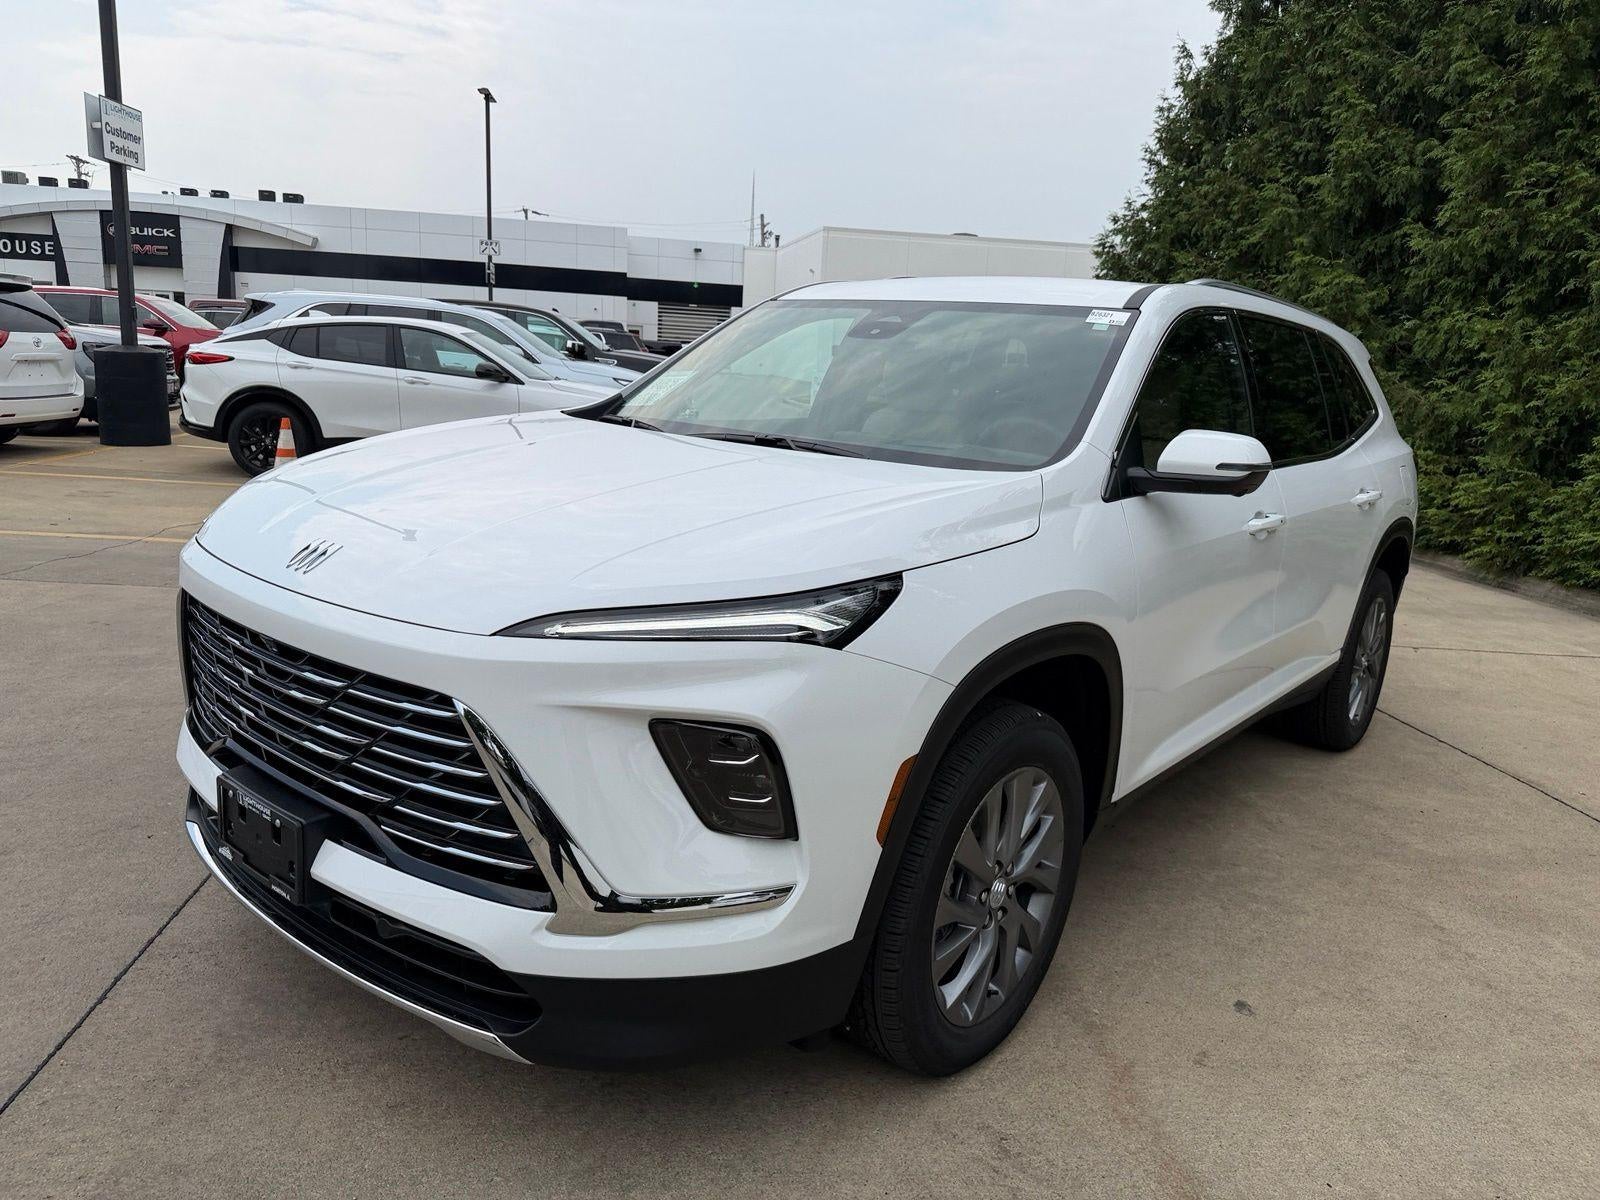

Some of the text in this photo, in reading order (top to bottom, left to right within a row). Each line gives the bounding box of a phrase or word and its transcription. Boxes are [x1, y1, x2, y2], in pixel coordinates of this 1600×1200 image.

[105, 122, 141, 144] Customer
[110, 141, 139, 163] Parking
[131, 244, 168, 255] MC
